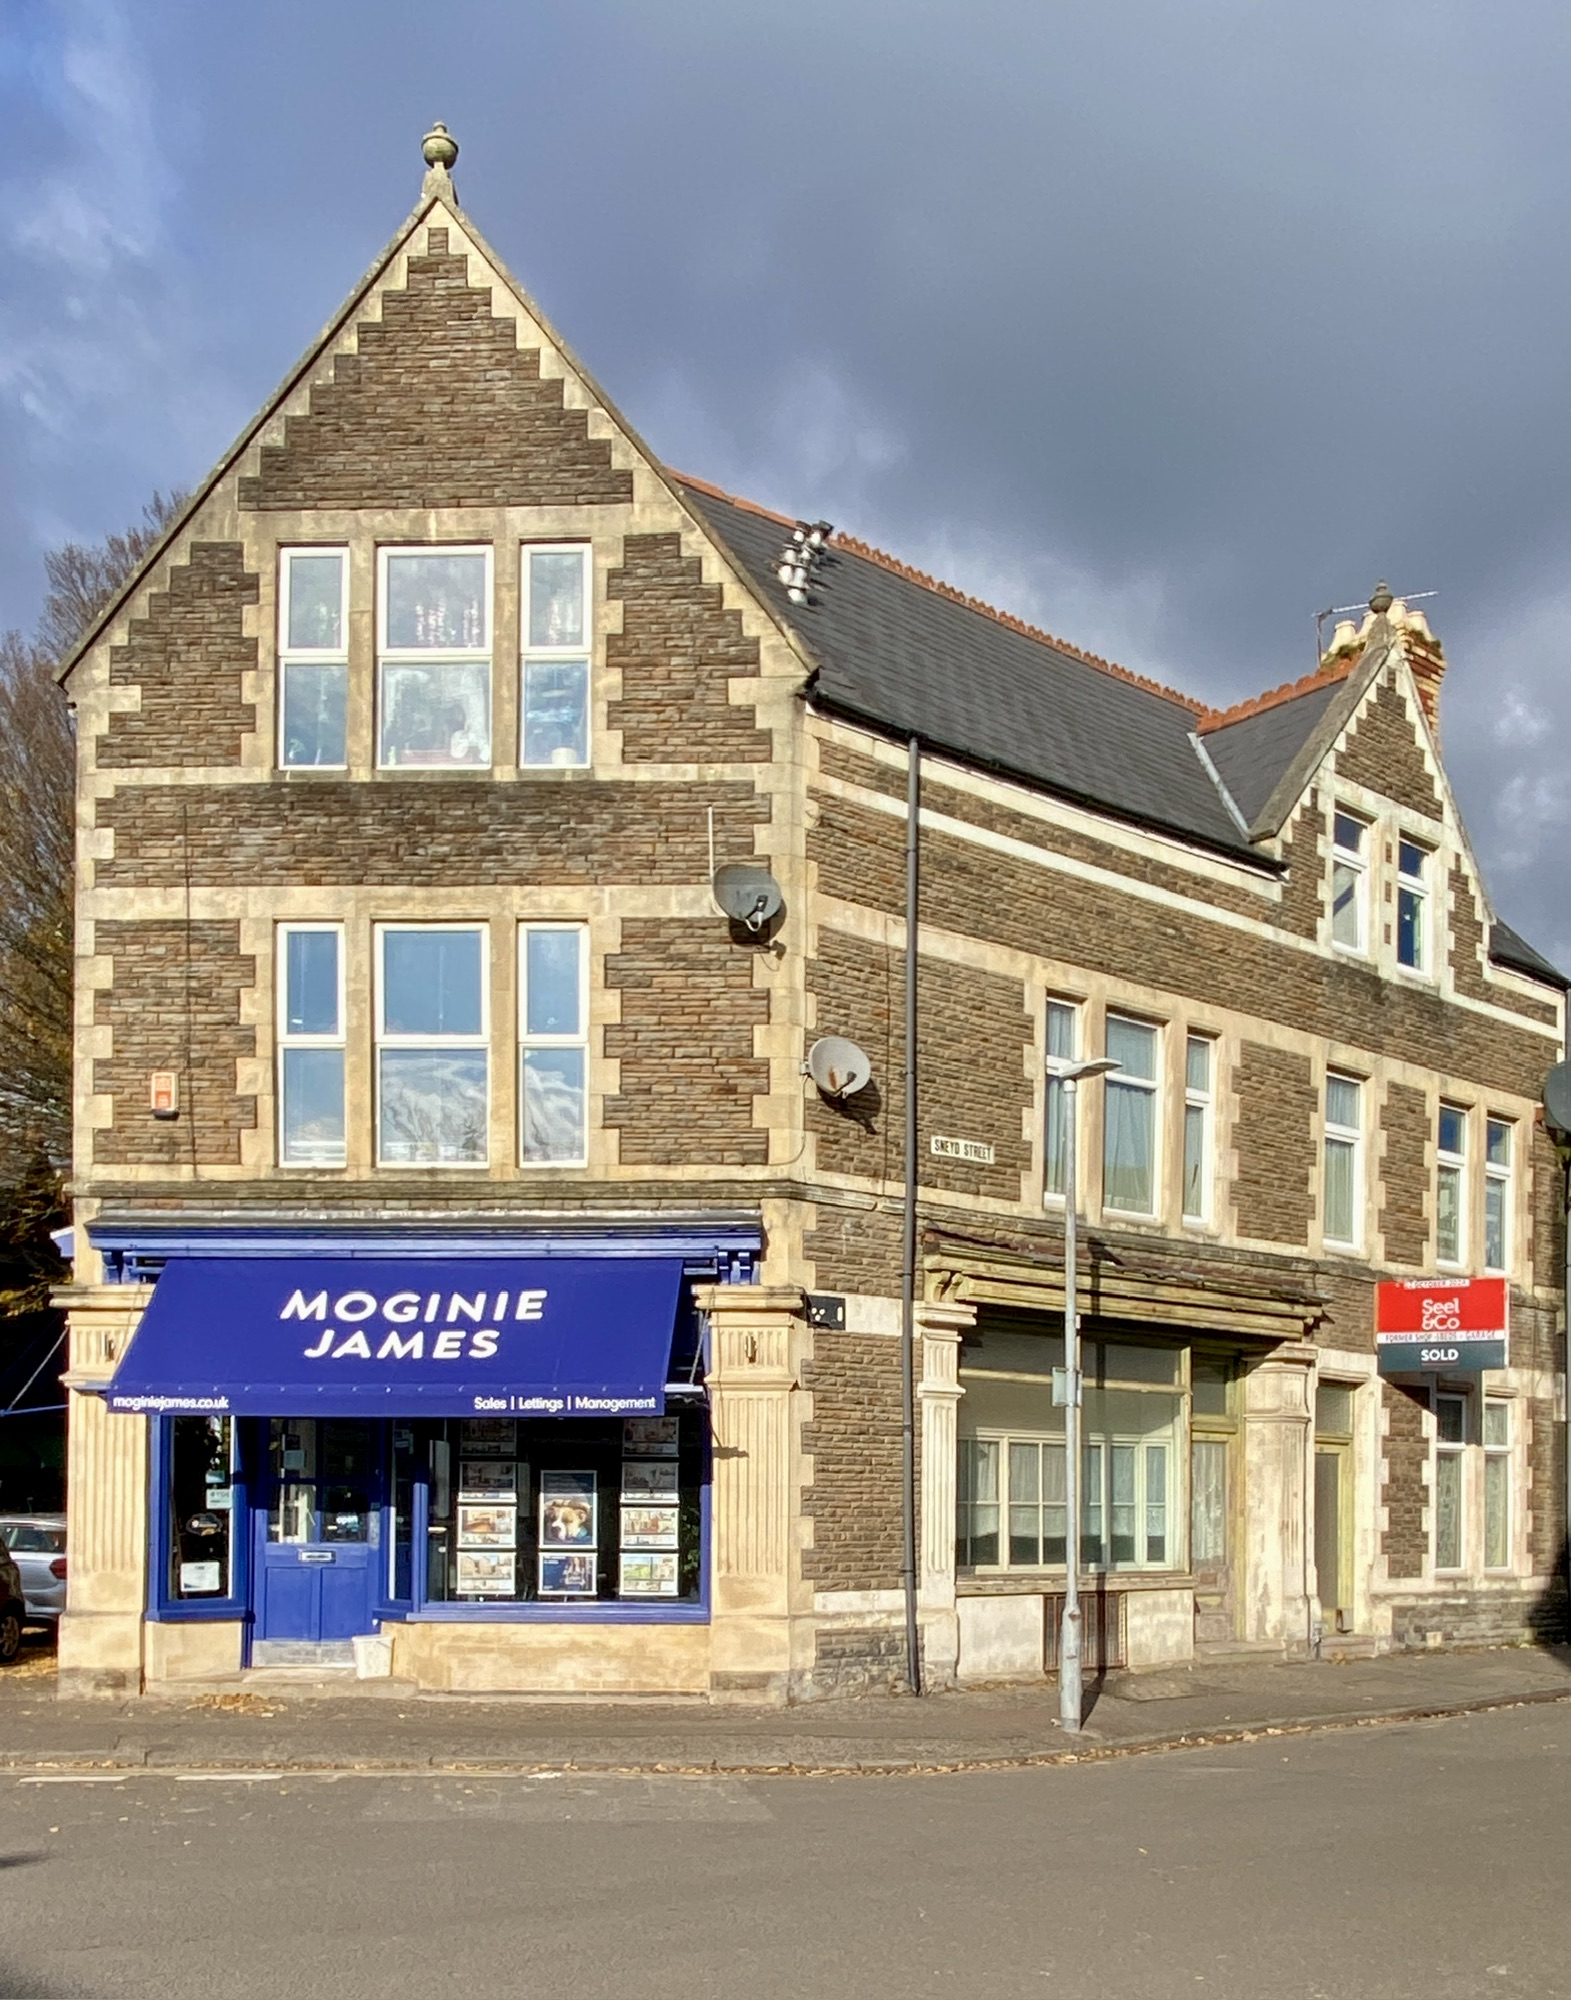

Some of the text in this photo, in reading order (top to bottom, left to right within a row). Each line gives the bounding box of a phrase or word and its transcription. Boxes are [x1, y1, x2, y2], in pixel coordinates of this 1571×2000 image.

[934, 1138, 992, 1161] SNEYD STREET
[279, 1289, 548, 1323] MOGINIE
[1421, 1297, 1460, 1315] Seel
[1421, 1315, 1460, 1331] &Co
[303, 1328, 501, 1359] JAMES
[1420, 1348, 1460, 1361] SOLD
[112, 1395, 230, 1412] moginiejames.co.uk
[474, 1396, 508, 1410] Sales
[518, 1396, 565, 1412] Lettings
[575, 1396, 657, 1412] Management
